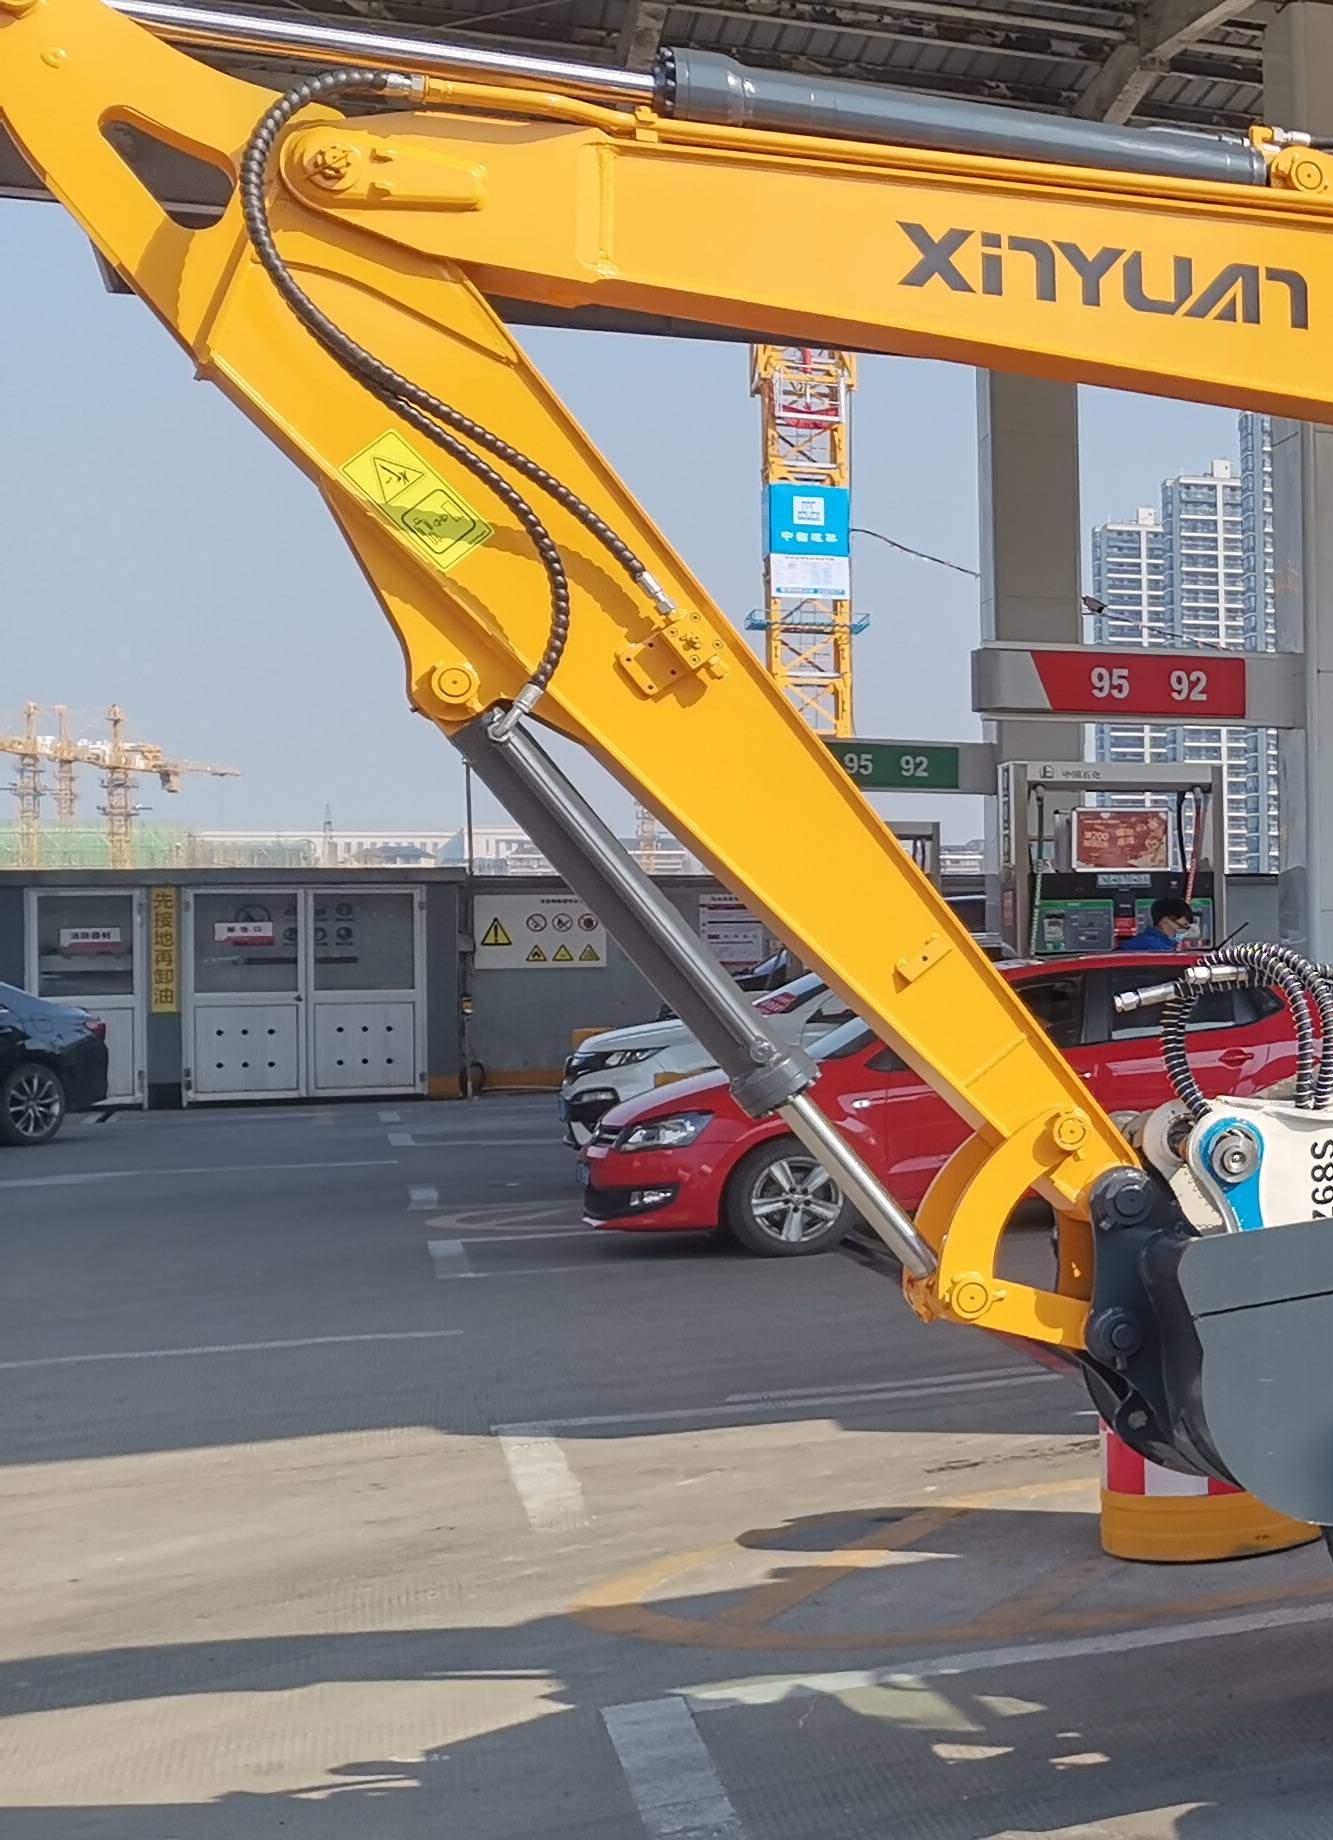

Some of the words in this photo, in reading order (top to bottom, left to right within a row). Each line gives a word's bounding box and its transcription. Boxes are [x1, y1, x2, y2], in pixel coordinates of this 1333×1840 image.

[1091, 667, 1130, 699] 95
[1170, 670, 1208, 701] 92
[845, 753, 873, 775] 95
[900, 755, 929, 777] 92
[154, 891, 175, 1004] 先接地再卸油
